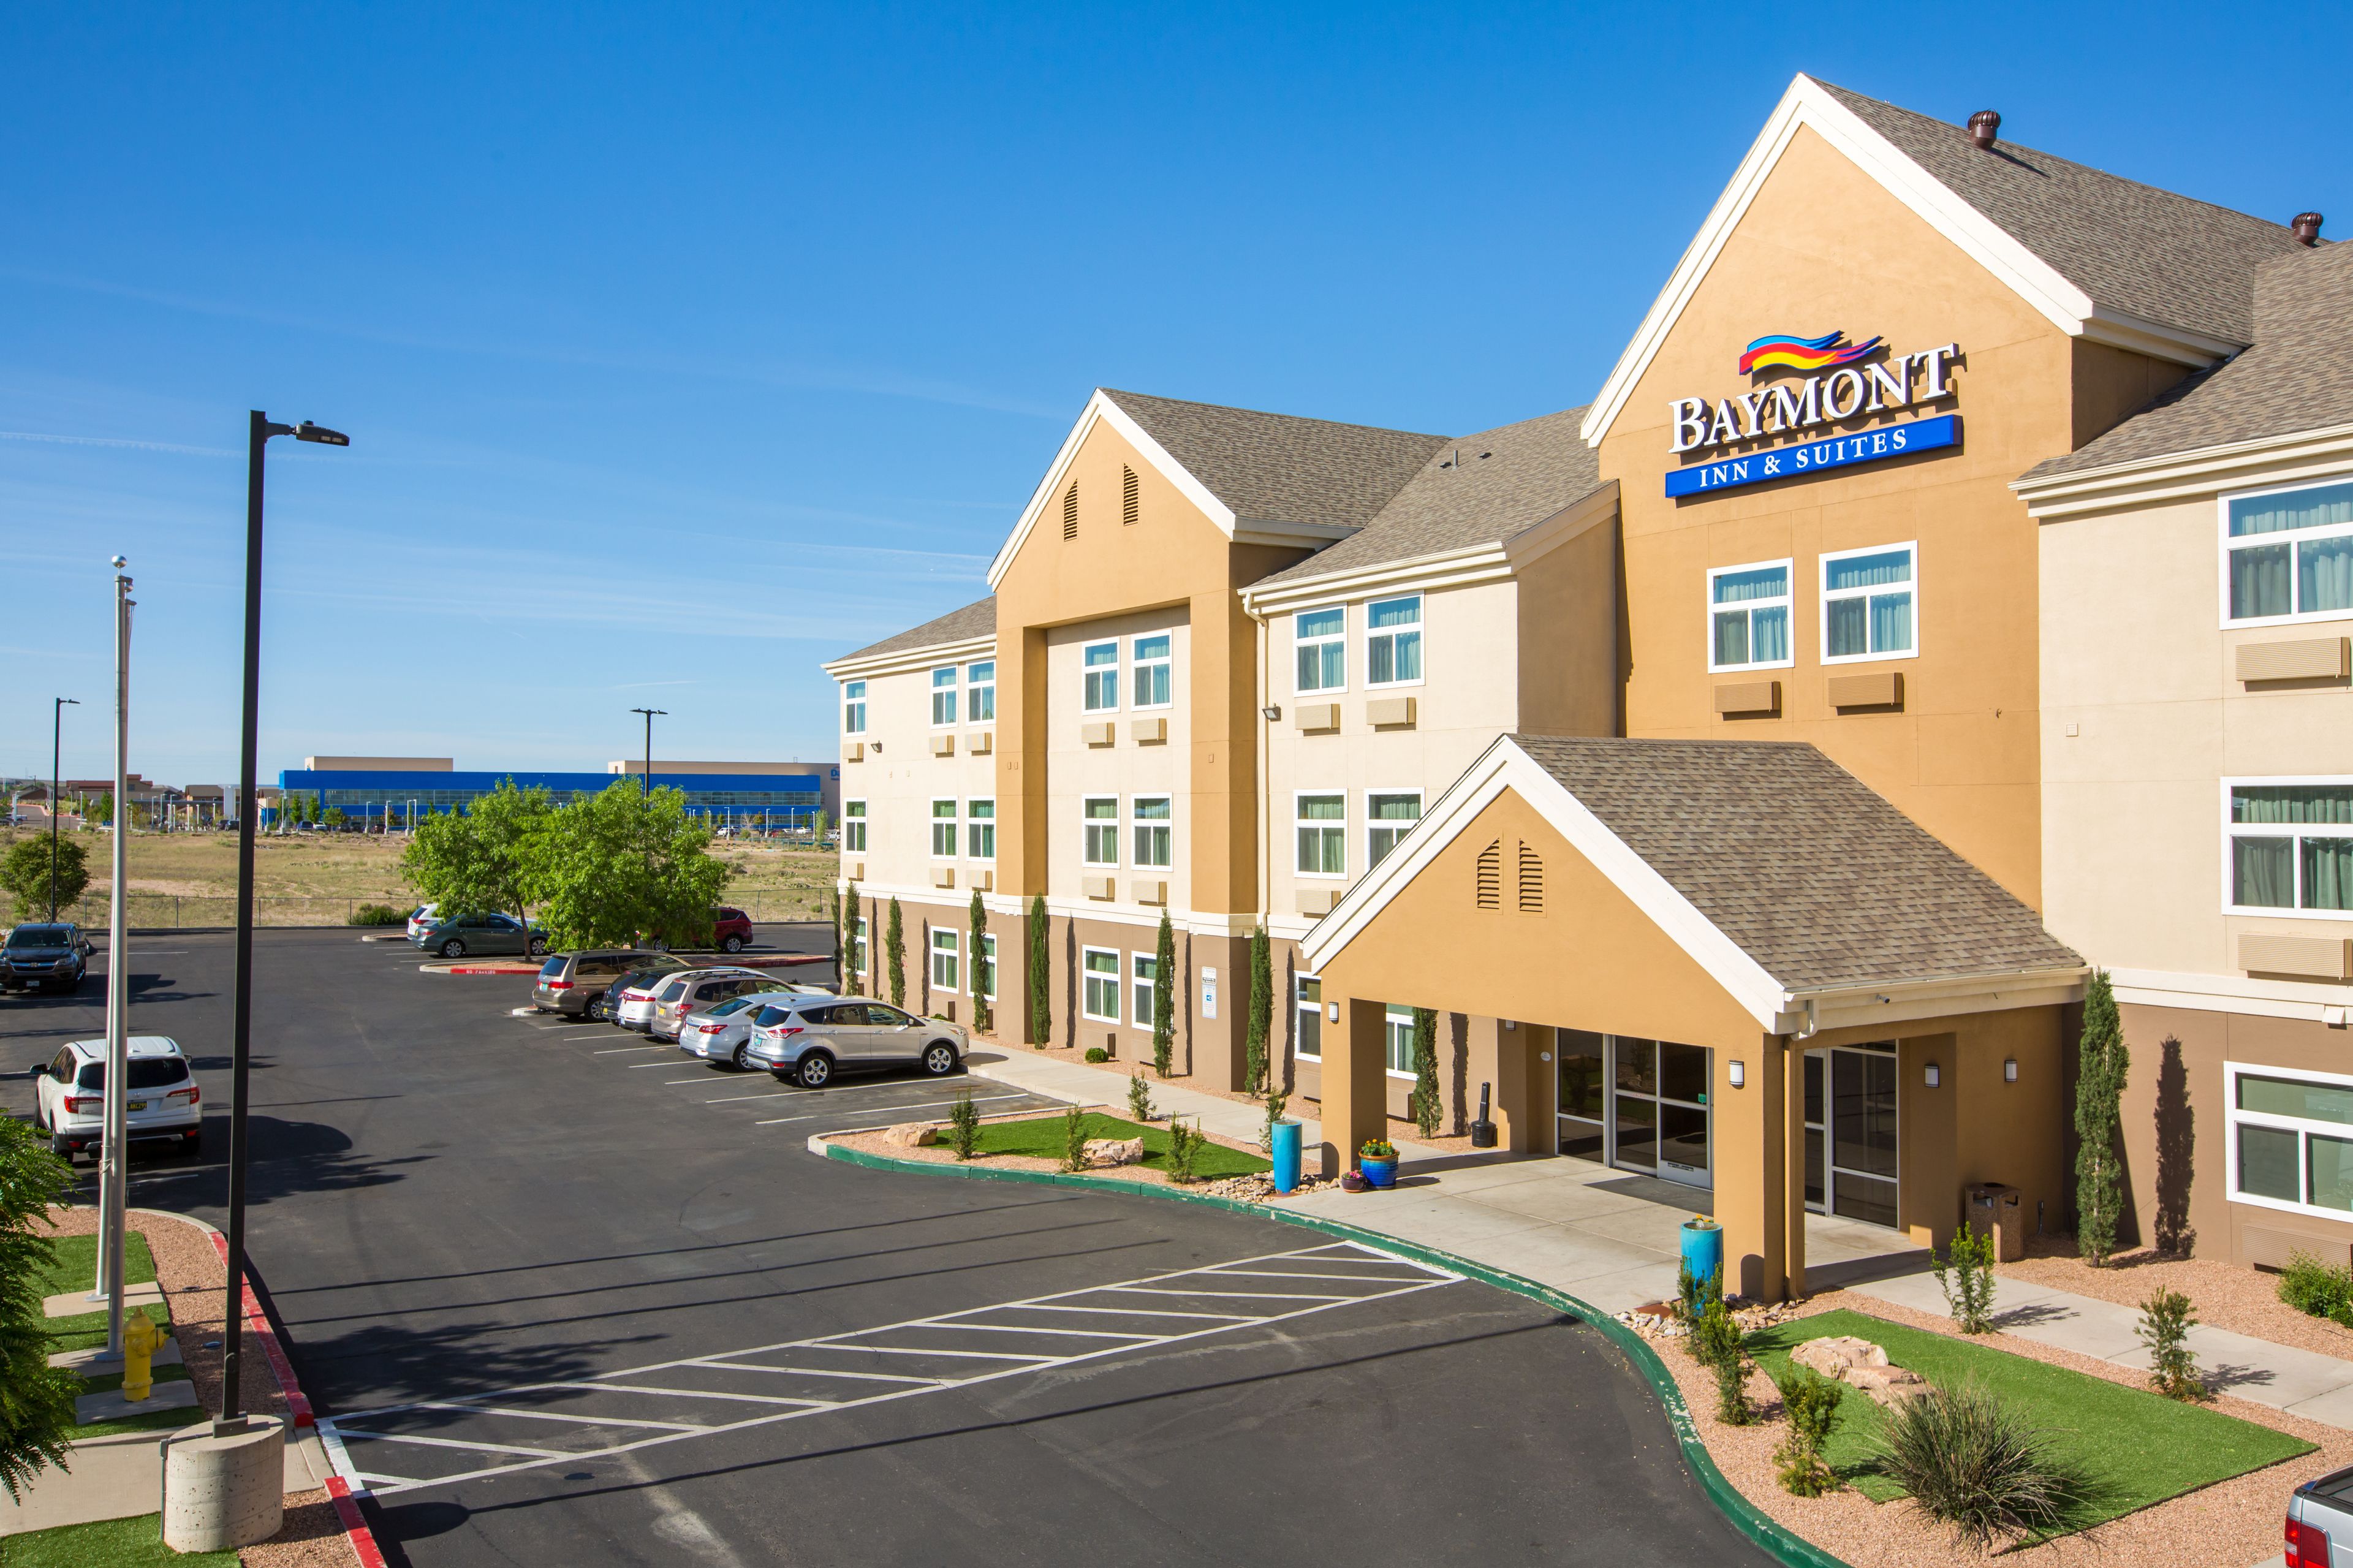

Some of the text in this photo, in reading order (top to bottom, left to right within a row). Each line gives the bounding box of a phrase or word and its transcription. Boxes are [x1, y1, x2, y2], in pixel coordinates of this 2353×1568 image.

[1668, 343, 1957, 453] BAYMONT
[1700, 429, 1907, 487] INN & SUITES
